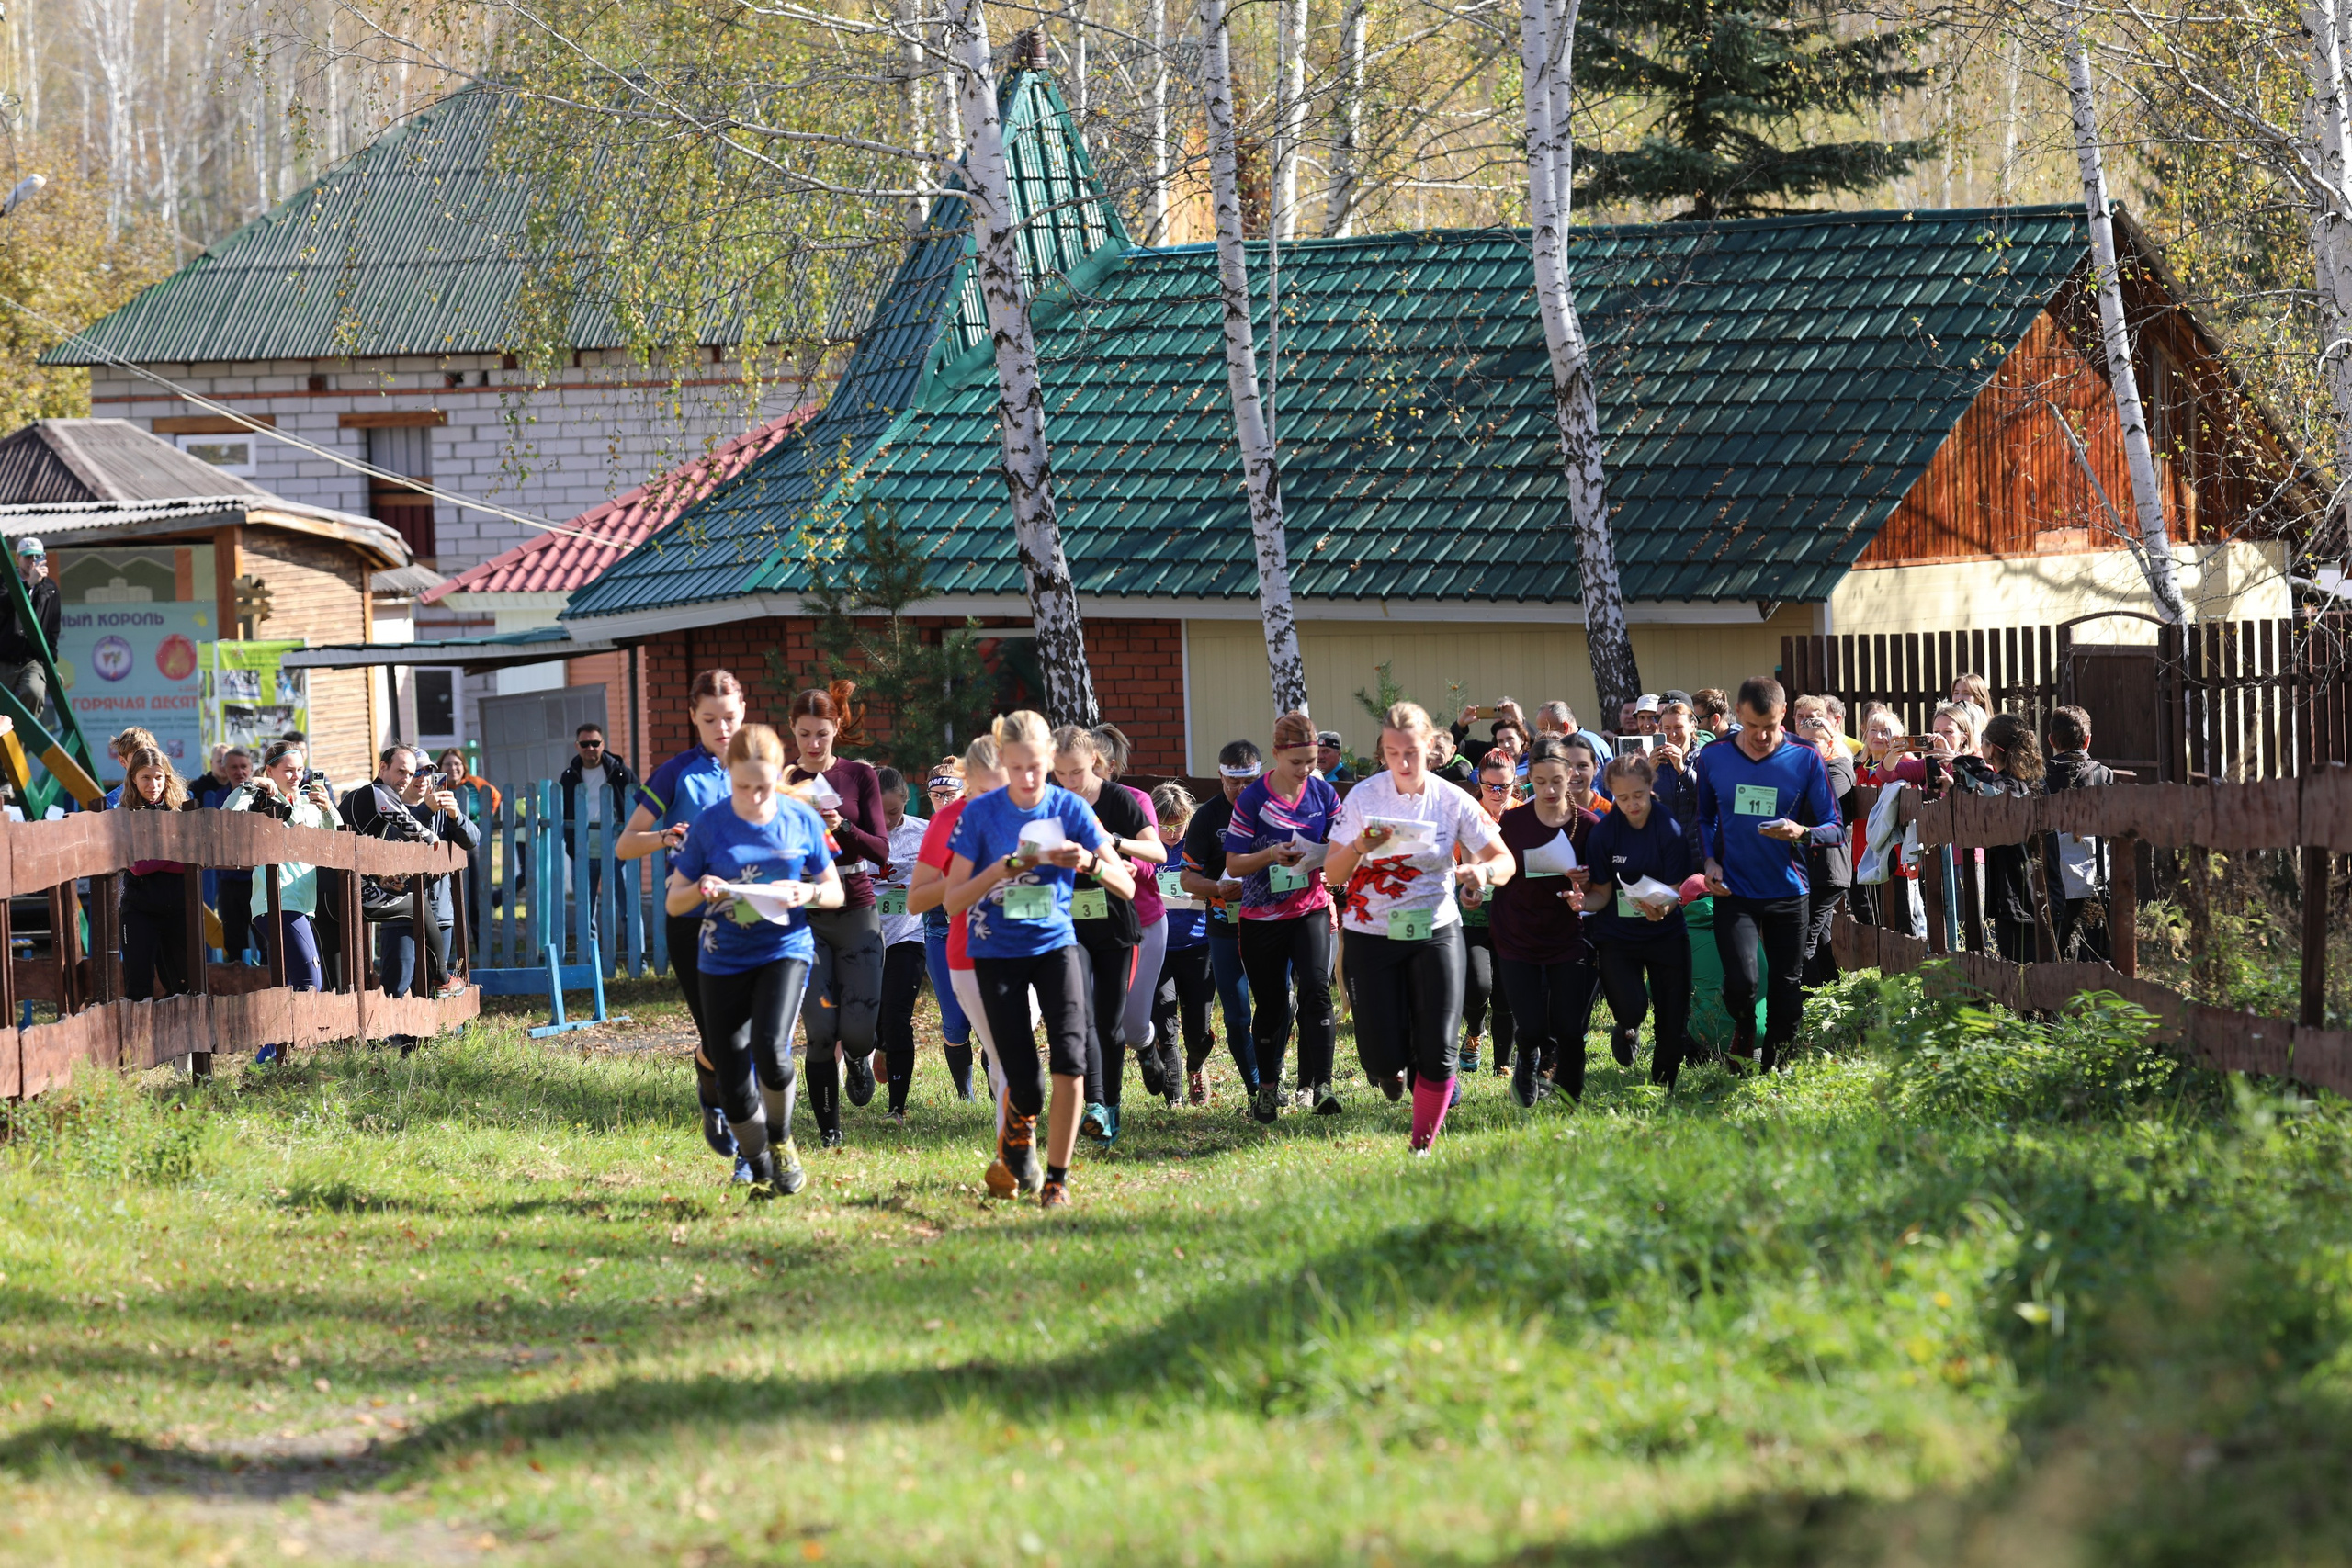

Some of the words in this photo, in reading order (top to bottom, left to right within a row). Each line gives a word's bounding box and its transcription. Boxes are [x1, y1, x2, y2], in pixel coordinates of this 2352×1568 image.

[97, 612, 164, 626] КОРОЛЬ
[72, 695, 146, 712] ГОРЯЧАЯ
[151, 695, 198, 710] ДЕСЯТ
[1749, 799, 1760, 814] 11
[1767, 805, 1772, 815] 2
[1286, 875, 1293, 888] 7
[1170, 883, 1178, 896] 5
[882, 900, 890, 914] 8
[898, 905, 903, 914] 2
[1025, 903, 1032, 919] 1
[1082, 904, 1091, 918] 3
[1406, 923, 1415, 939] 9
